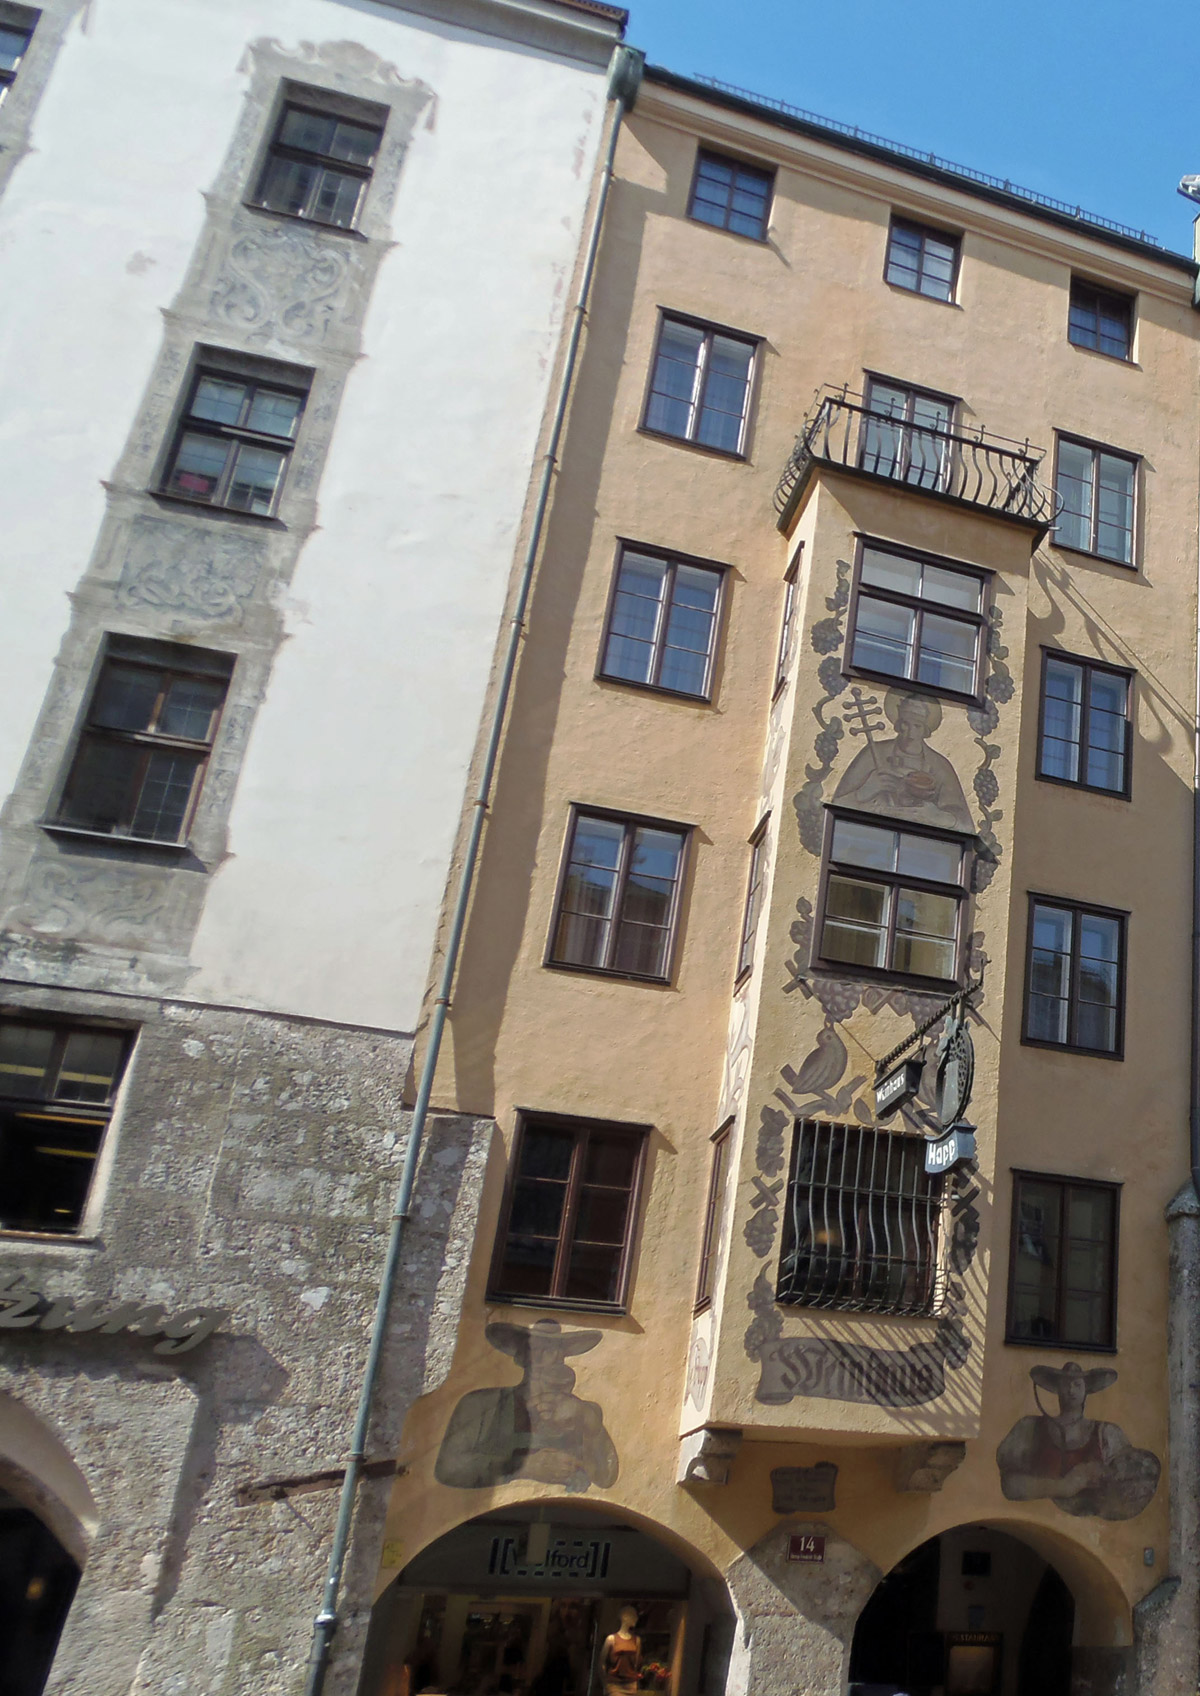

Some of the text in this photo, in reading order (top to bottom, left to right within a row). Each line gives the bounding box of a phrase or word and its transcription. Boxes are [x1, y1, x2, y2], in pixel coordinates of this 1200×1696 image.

[928, 1139, 956, 1166] Happ
[0, 1273, 233, 1356] zung
[800, 1536, 815, 1552] 14
[511, 1548, 590, 1569] lford
